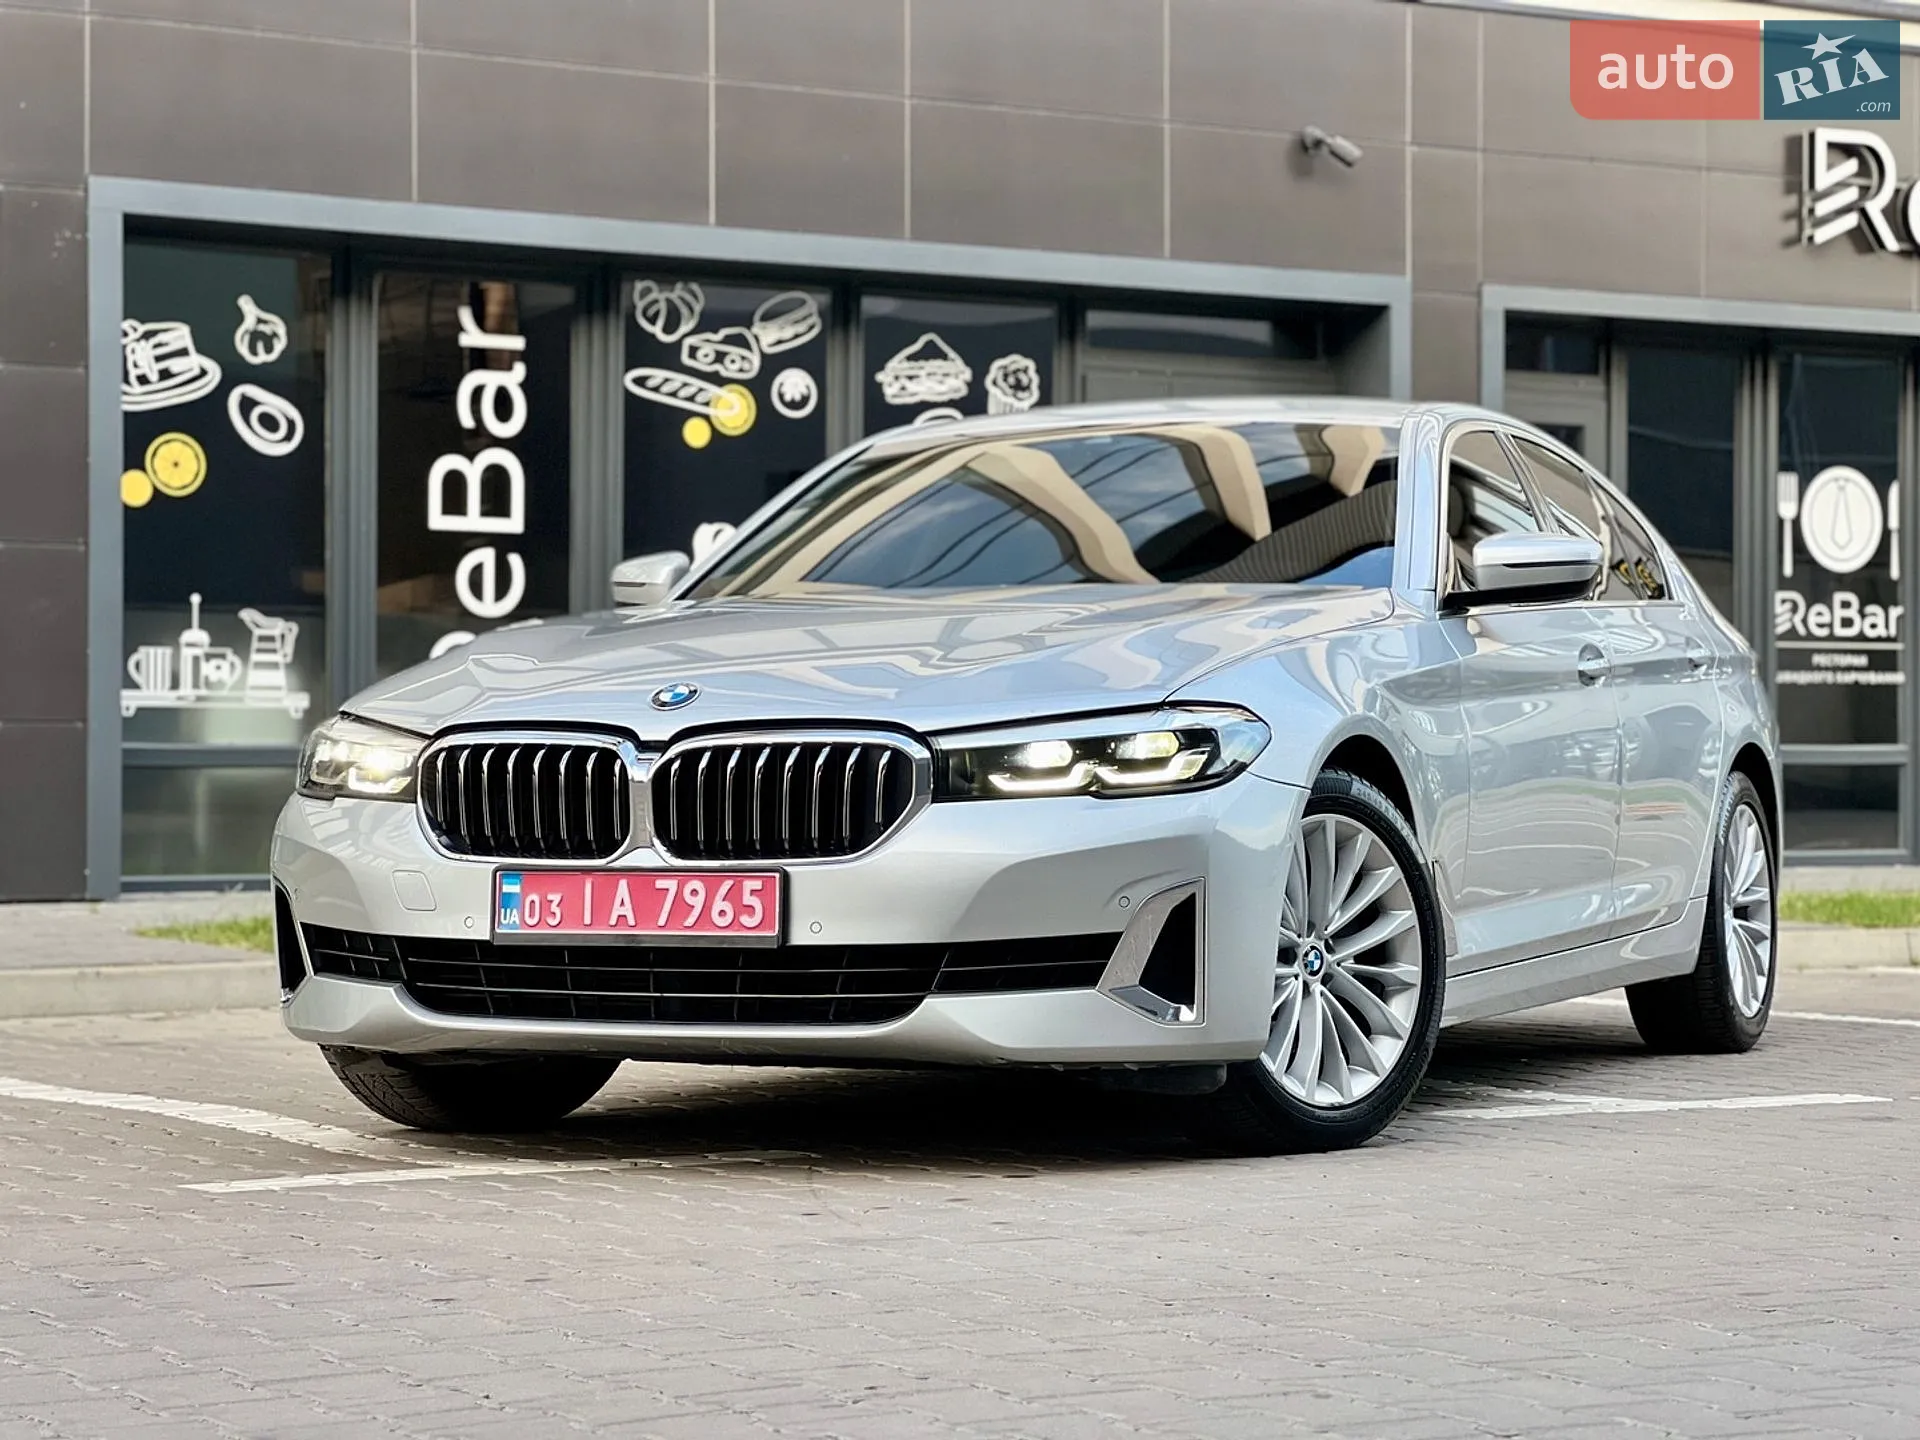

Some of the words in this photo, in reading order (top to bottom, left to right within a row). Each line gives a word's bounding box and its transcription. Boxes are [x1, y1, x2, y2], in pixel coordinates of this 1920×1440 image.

[1812, 127, 1920, 252] R
[427, 305, 528, 660] eBar
[1774, 590, 1905, 638] ReBar
[501, 908, 520, 925] UA
[523, 893, 563, 927] 03
[654, 878, 764, 928] 7965
